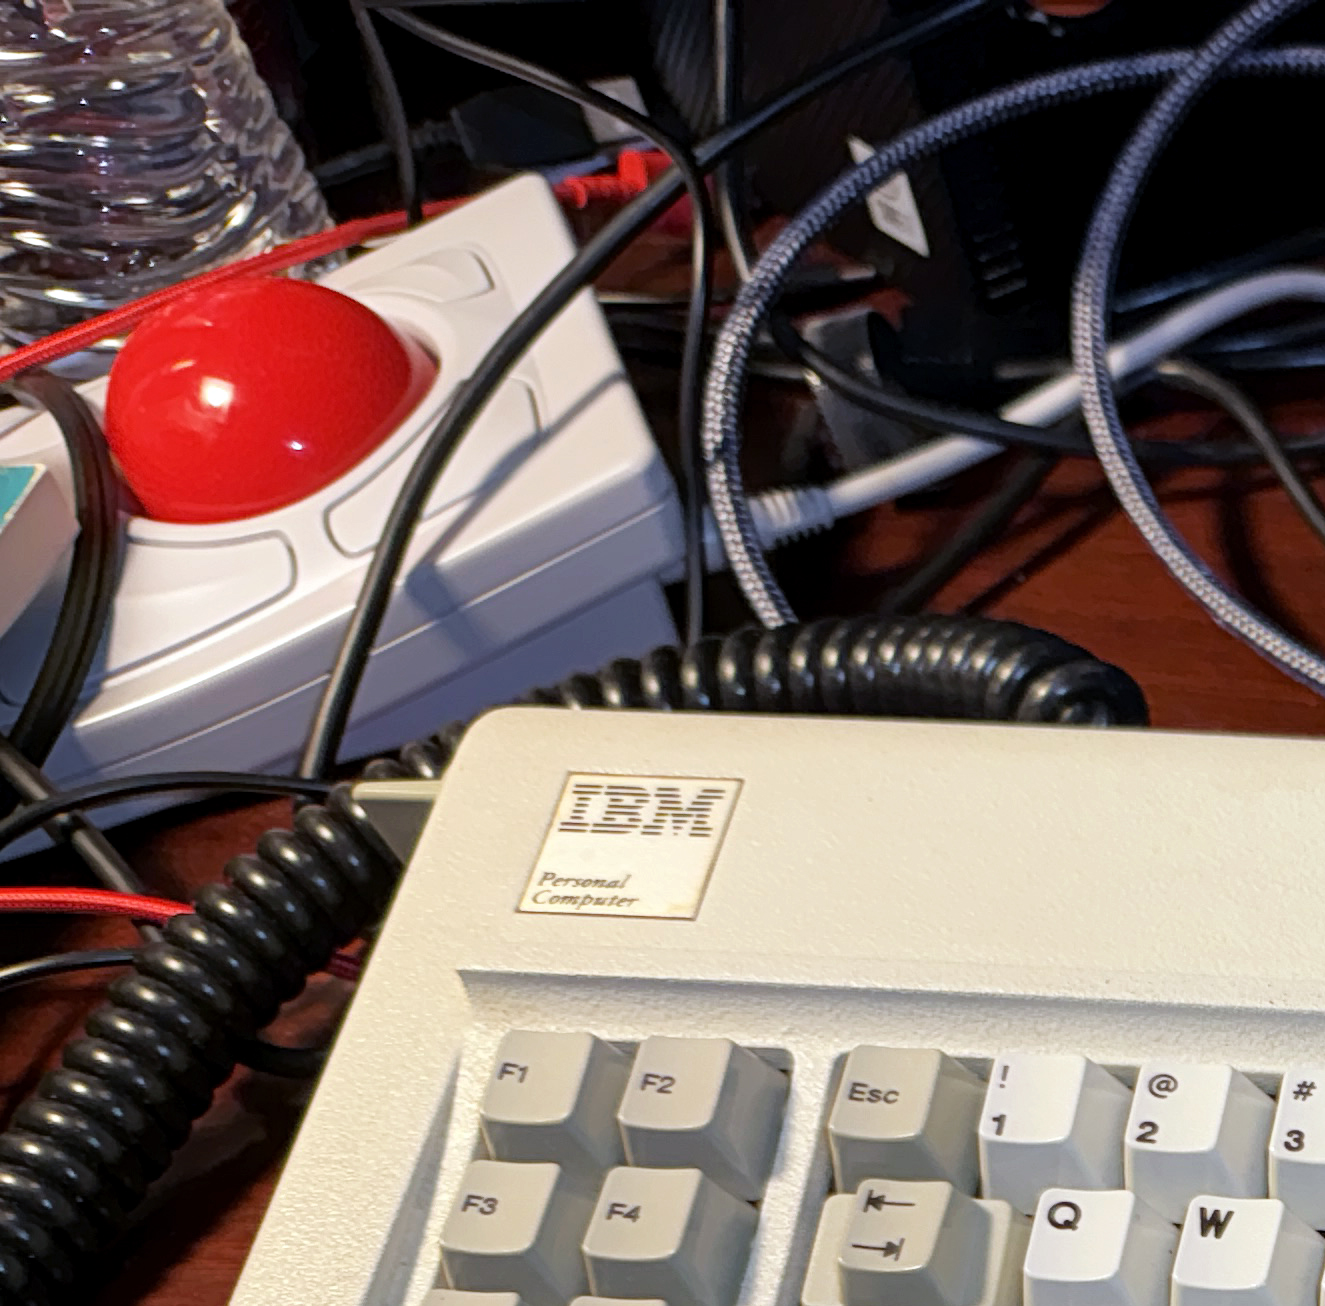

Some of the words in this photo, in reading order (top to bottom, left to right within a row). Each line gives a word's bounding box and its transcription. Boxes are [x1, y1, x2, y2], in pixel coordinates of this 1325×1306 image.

[557, 783, 726, 838] IBM
[537, 870, 633, 891] Personal
[531, 889, 640, 911] Computer
[498, 1062, 528, 1083] F1
[640, 1073, 675, 1094] F2
[848, 1082, 899, 1104] Esc
[992, 1114, 1006, 1136] 1
[1135, 1121, 1159, 1144] 2
[1283, 1129, 1305, 1152] 3
[461, 1195, 498, 1215] F3
[606, 1203, 640, 1222] F4
[1047, 1201, 1081, 1231] Q
[1199, 1207, 1234, 1239] W
